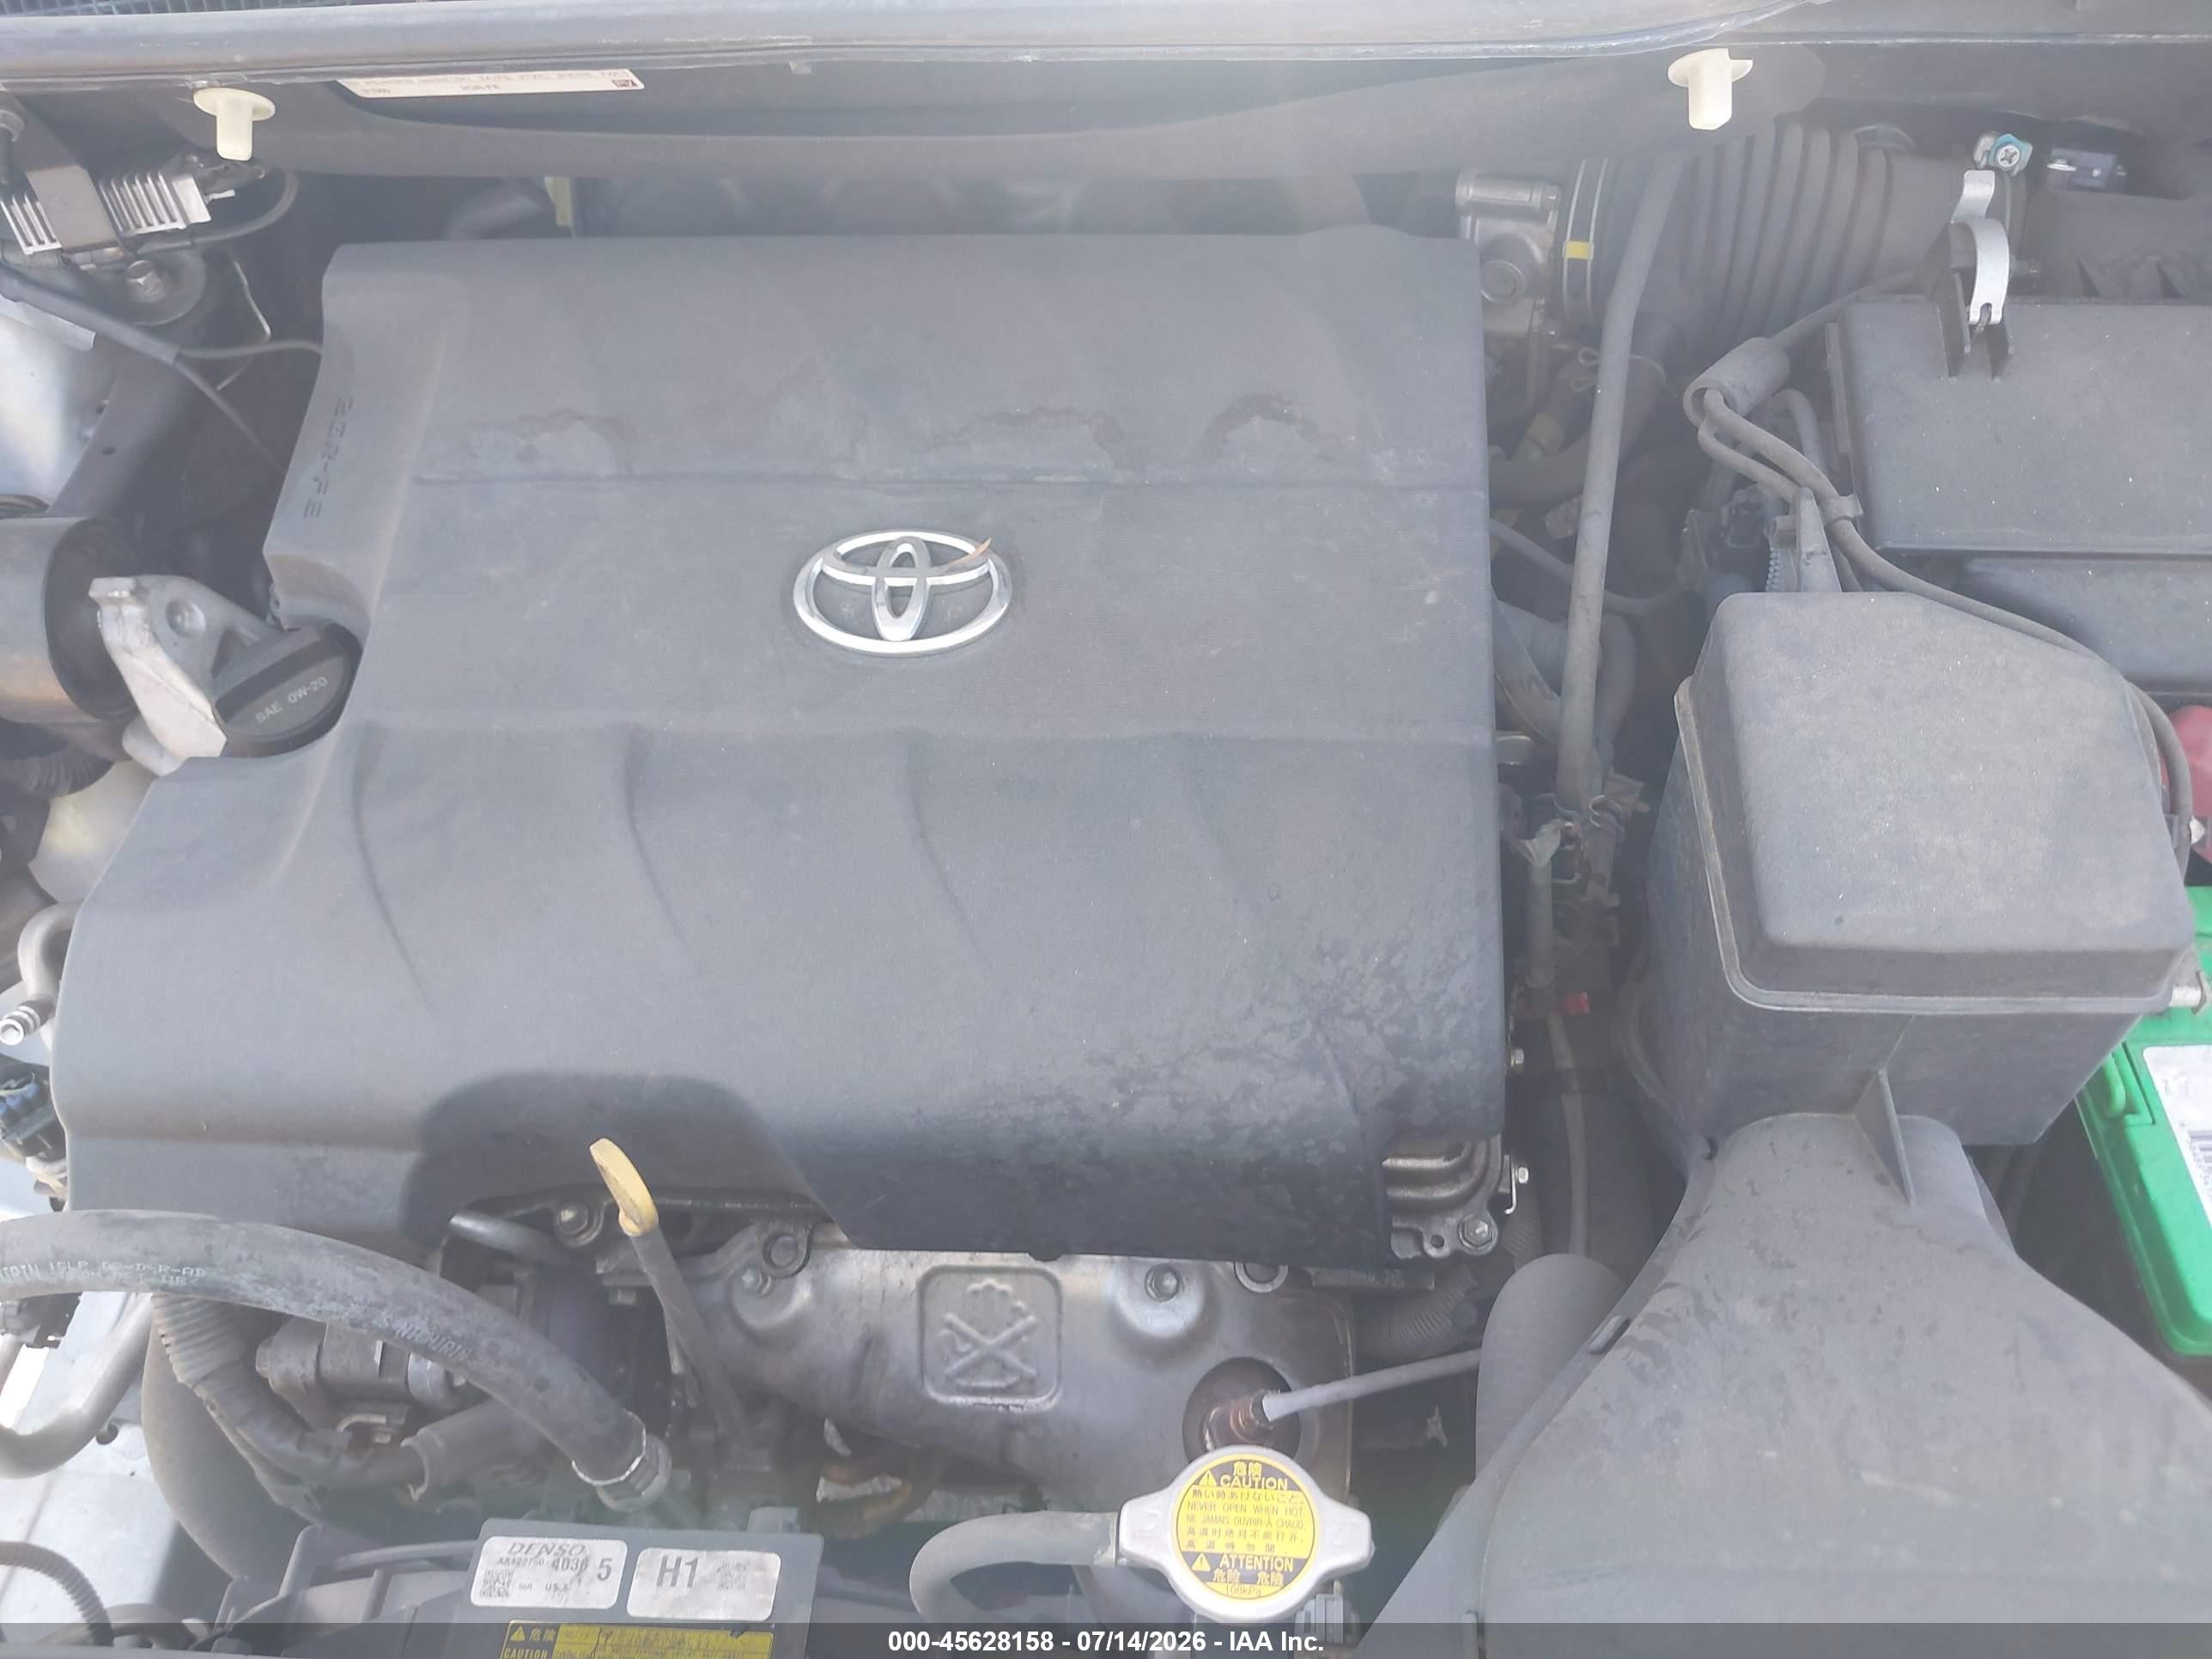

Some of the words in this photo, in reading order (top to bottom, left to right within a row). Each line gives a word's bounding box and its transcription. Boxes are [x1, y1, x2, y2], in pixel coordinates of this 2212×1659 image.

[255, 701, 283, 725] SAE
[287, 676, 328, 704] 0W-20
[1220, 1474, 1287, 1490] CAUTION
[1188, 1502, 1216, 1511] NEVER
[1223, 1504, 1247, 1512] OPEN
[1254, 1505, 1278, 1515] WHEN
[1201, 1515, 1229, 1524] JAMAIS
[1234, 1516, 1262, 1526] OUVRIR
[507, 1542, 586, 1557] DENSO
[597, 1558, 613, 1581] 5
[1219, 1553, 1293, 1572] ATTENTION
[656, 1555, 699, 1589] H1
[504, 1648, 548, 1659] CAUTION
